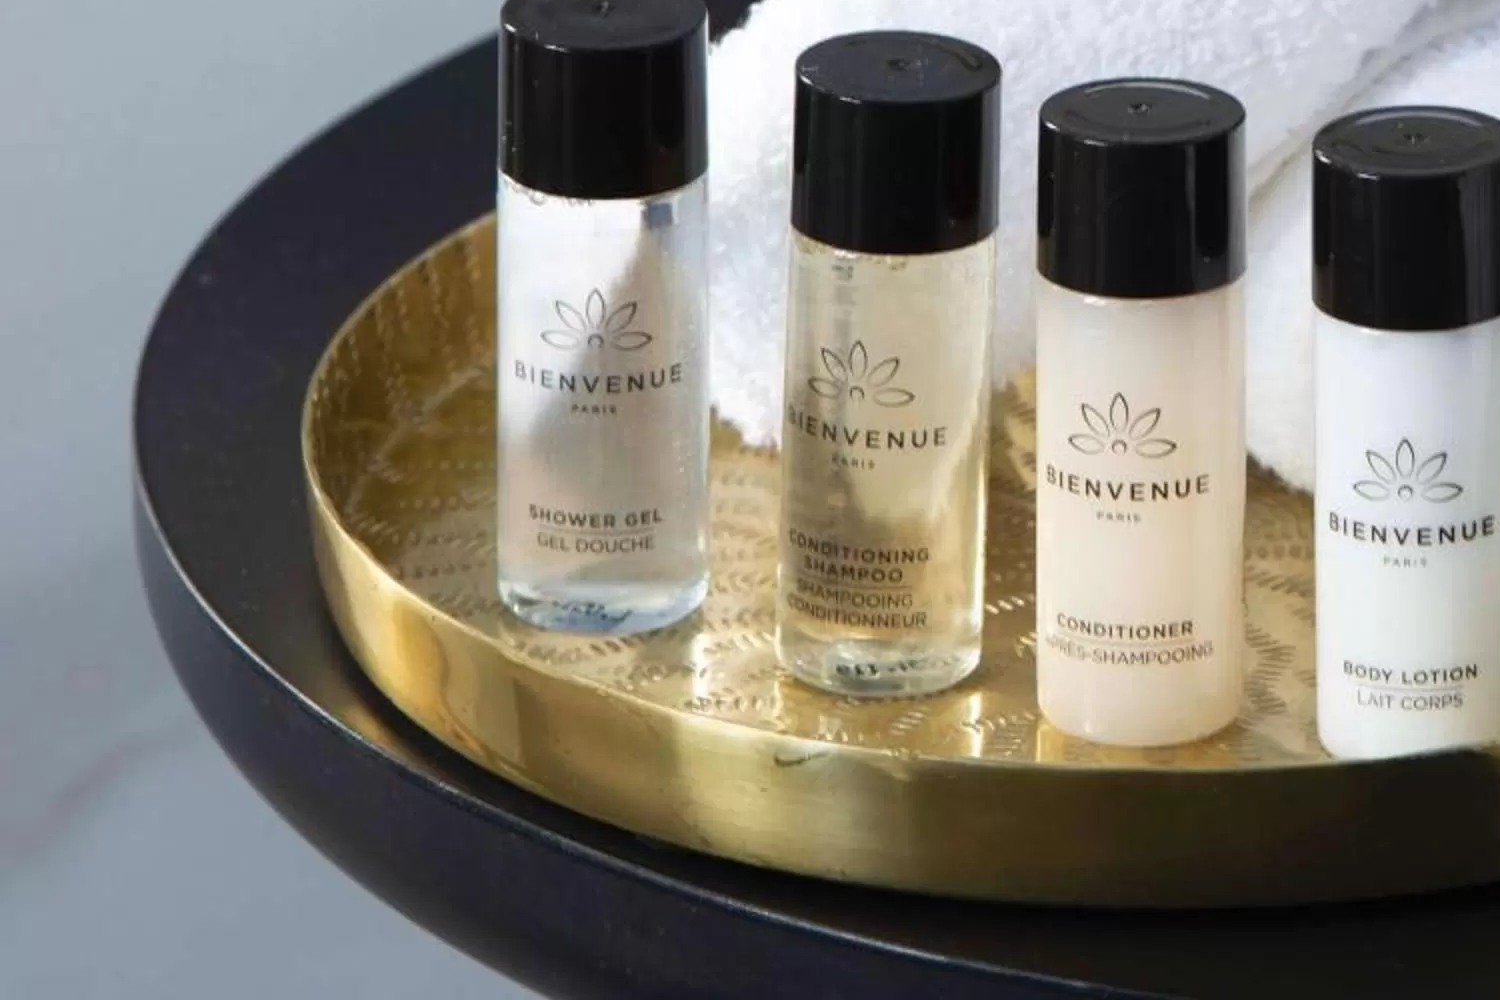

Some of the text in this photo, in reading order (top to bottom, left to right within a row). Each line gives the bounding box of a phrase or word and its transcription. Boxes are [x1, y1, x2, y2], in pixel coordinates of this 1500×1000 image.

[514, 359, 683, 395] BIENVENUE
[570, 402, 618, 417] PARIS
[787, 403, 949, 451] BIENVENUE
[831, 454, 876, 471] PARIS
[1045, 463, 1211, 502] BIENVENUE
[527, 502, 663, 529] SHOWER GEL
[1096, 510, 1142, 524] PARIS
[1328, 511, 1496, 547] BIENVENUE
[536, 532, 655, 554] GEL DOUCHE
[788, 527, 930, 565] CONDITIONING
[803, 555, 903, 585] SHAMPOO
[1383, 556, 1428, 569] PARIS
[797, 578, 913, 609] SHAMPOOING
[787, 593, 927, 630] CONDITIONNEUR
[1056, 612, 1194, 641] CONDITIONER
[1343, 659, 1479, 686] BODY LOTION
[1356, 688, 1464, 712] LAIT CORPS
